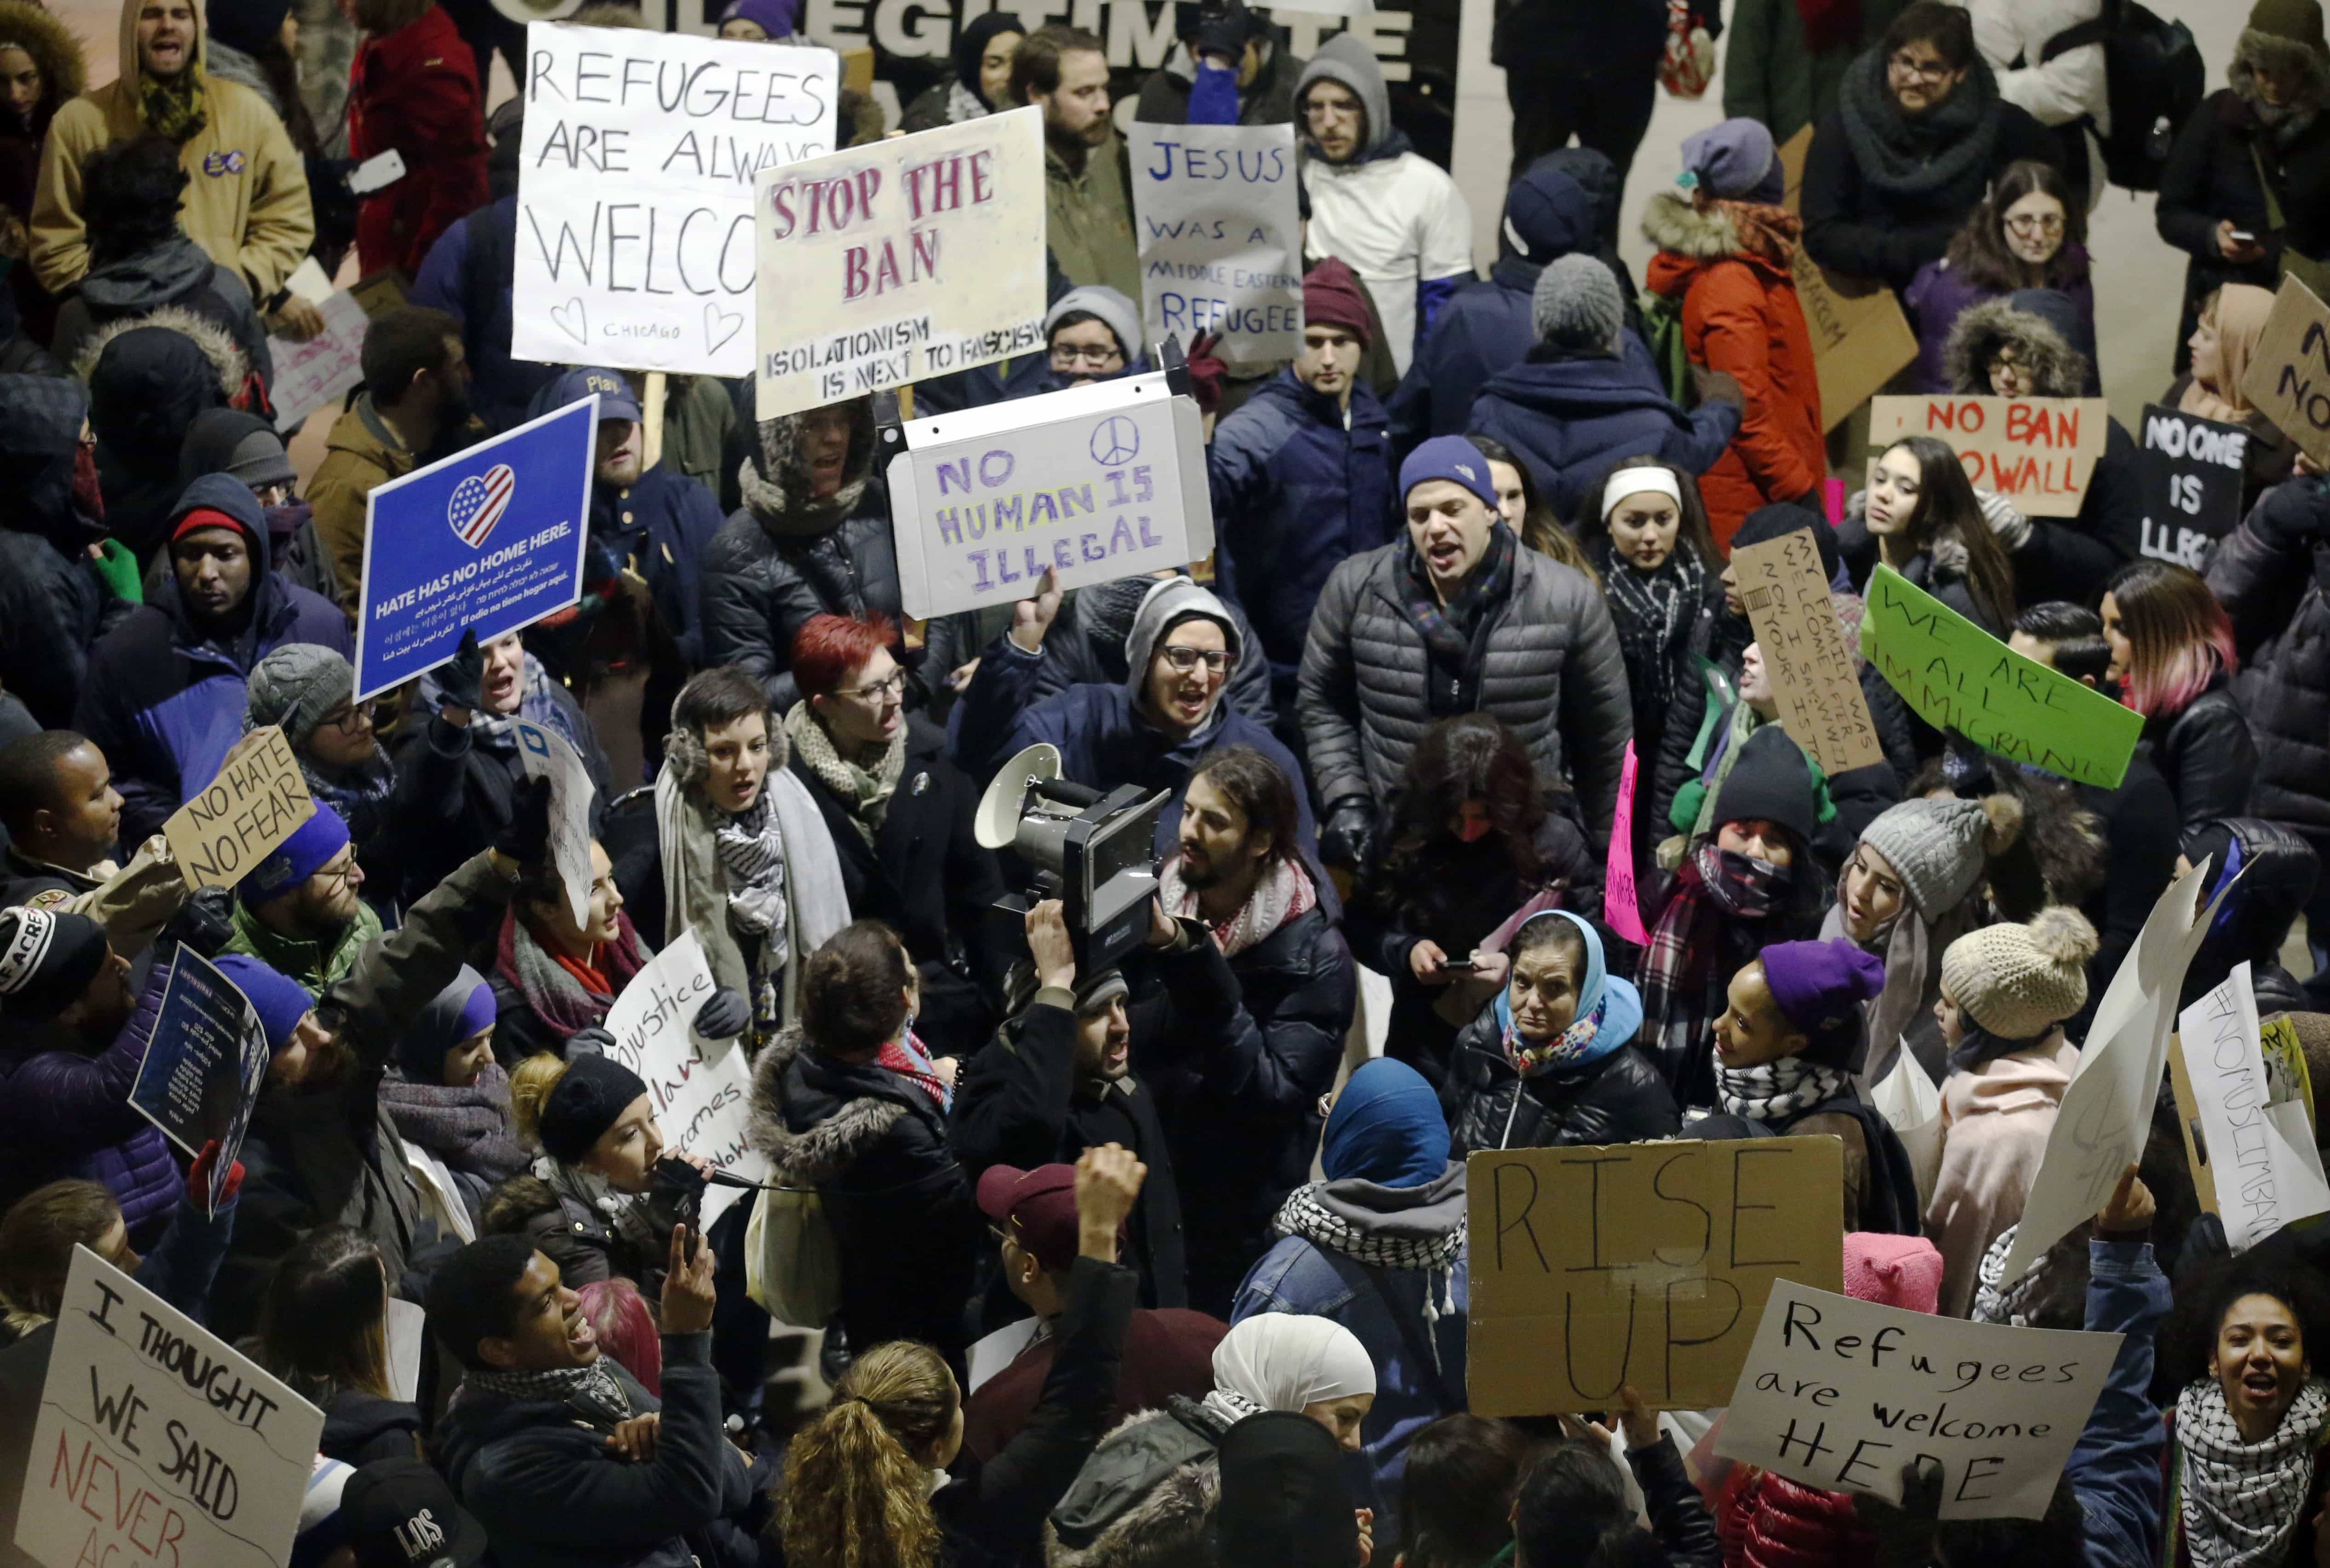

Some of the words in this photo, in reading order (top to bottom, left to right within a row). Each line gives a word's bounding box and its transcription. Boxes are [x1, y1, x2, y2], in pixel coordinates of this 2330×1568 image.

[531, 50, 824, 126] REFUGEES
[538, 120, 629, 172] ARE
[1148, 141, 1284, 183] JESUS
[773, 167, 883, 241] STOP
[903, 149, 993, 221] THE
[1146, 215, 1224, 239] WAS
[1247, 228, 1267, 243] A
[843, 230, 938, 301] BAN
[1148, 261, 1226, 286] MIDDLE
[1234, 269, 1303, 288] EASTERN
[603, 323, 680, 339] CHICAGO
[766, 317, 929, 379] ISOLATIONISM
[1160, 292, 1297, 334] REFUGEE
[822, 367, 845, 399] IS
[855, 353, 911, 391] NEXT
[926, 344, 952, 372] TO
[960, 317, 1047, 361] FASCISM
[1927, 401, 1984, 433] NO
[2006, 403, 2079, 449] BAN
[934, 450, 1015, 496] NO
[936, 482, 1096, 546] HUMAN
[1105, 465, 1154, 508] IS
[1992, 456, 2079, 494] WALL
[2170, 474, 2204, 515] IS
[376, 589, 415, 620] HATE
[419, 574, 450, 601] HAS
[453, 562, 477, 585] NO
[480, 539, 527, 573] HOME
[530, 521, 571, 551] HERE.
[968, 514, 1163, 595] ILLEGAL
[461, 615, 469, 627] El
[470, 608, 489, 623] odio
[490, 603, 501, 613] no
[502, 593, 523, 608] tiene
[524, 581, 548, 599] hogar
[1784, 543, 1832, 666] WELCOME
[1824, 677, 1852, 738] AFTER
[1787, 629, 1801, 647] I
[1764, 613, 1796, 686] YOURS
[1792, 698, 1811, 729] IS
[1794, 535, 1819, 576] MY
[1816, 596, 1852, 684] FAMILY
[1849, 698, 1873, 749] WAS
[1884, 584, 1958, 645] WE
[1990, 657, 2073, 714] ARE
[1926, 657, 2006, 718] ALL
[1817, 702, 1847, 767] WWII
[188, 786, 229, 831] NO
[228, 732, 291, 801] HATE
[190, 835, 239, 887] NO
[233, 772, 309, 854] FEAR
[1494, 1147, 1800, 1273] RISE
[89, 1279, 124, 1336] I
[139, 1311, 278, 1431] THOUGHT
[1565, 1277, 1743, 1401] UP
[1783, 1300, 2080, 1393] Refugees
[1755, 1372, 1840, 1407] are
[1873, 1402, 2052, 1440] welcome
[90, 1365, 149, 1455] WE
[158, 1419, 238, 1521] SAID
[49, 1427, 185, 1568] NEVER
[393, 1508, 443, 1558] LOS
